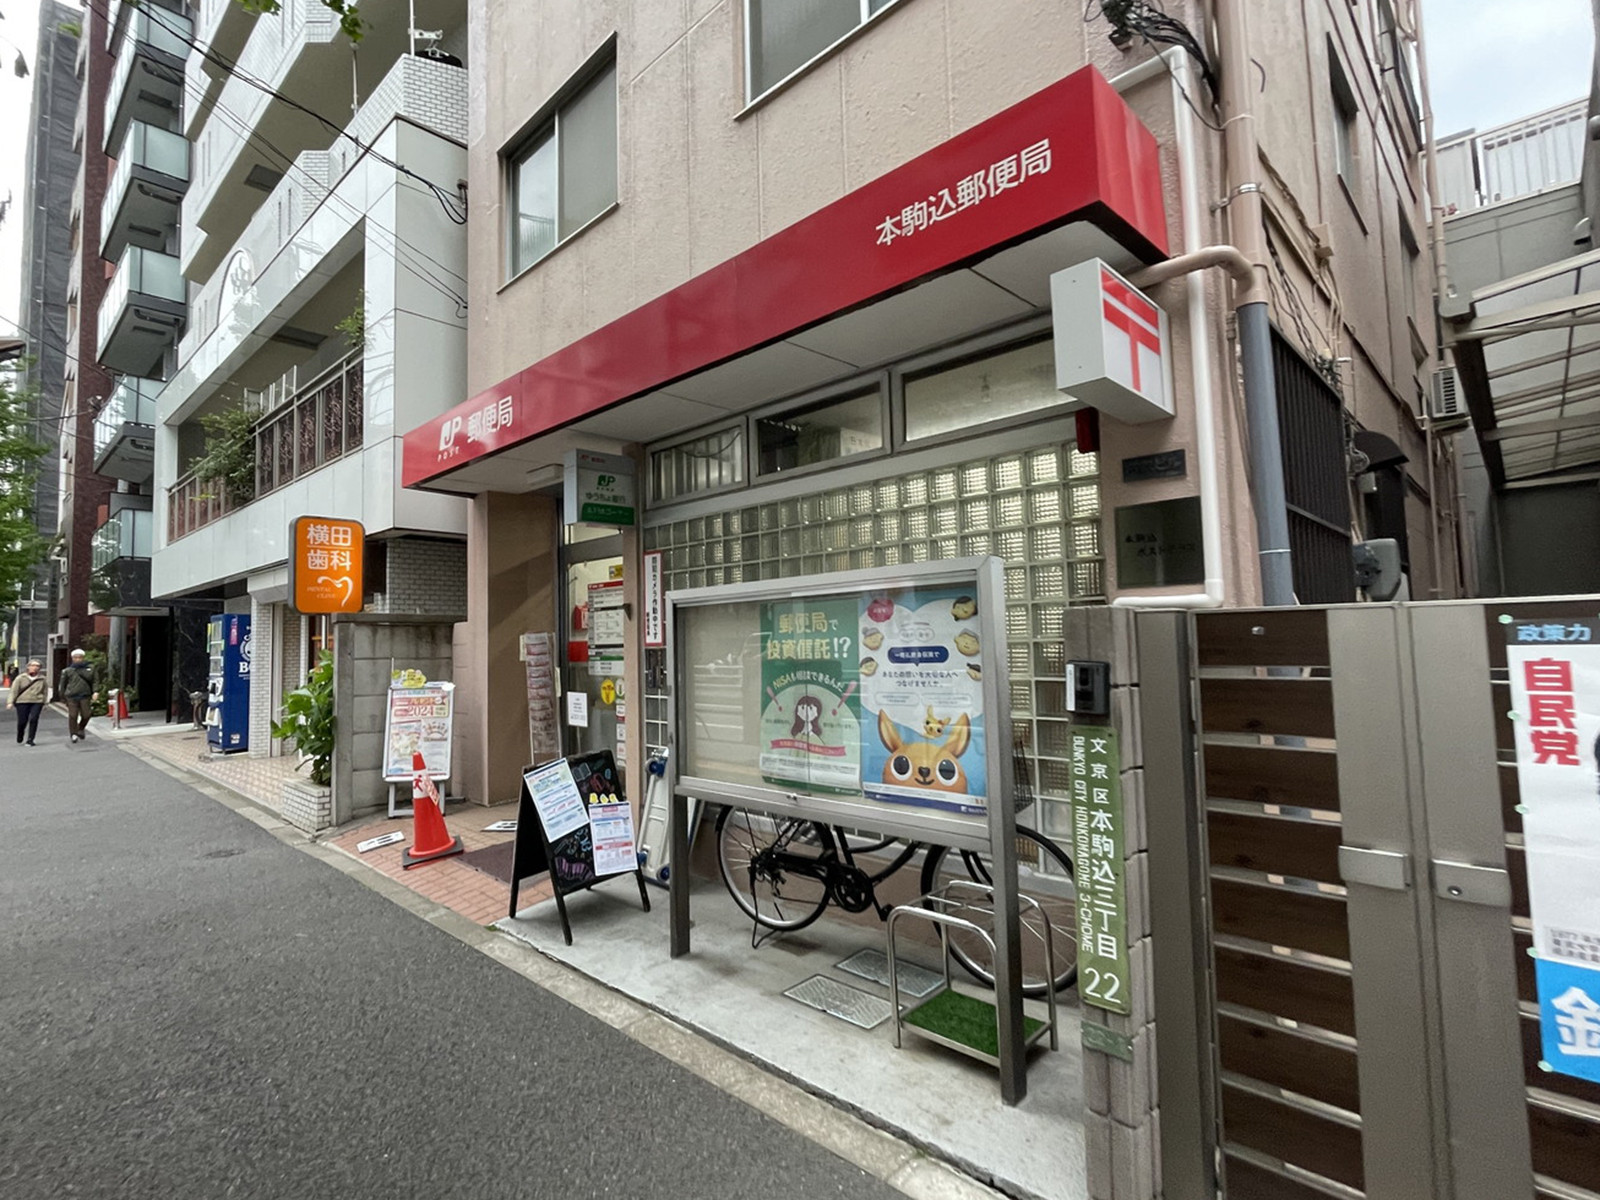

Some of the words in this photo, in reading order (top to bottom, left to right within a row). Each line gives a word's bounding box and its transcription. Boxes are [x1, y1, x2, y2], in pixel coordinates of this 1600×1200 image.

[875, 138, 1052, 245] 本駒込郵便局
[467, 395, 513, 443] 郵便局
[437, 446, 460, 462] POST
[307, 523, 352, 547] 横田
[307, 549, 352, 571] 歯科
[778, 612, 839, 634] 郵便局で
[1516, 624, 1592, 642] 政策力
[1523, 658, 1581, 766] 自民党
[1072, 736, 1086, 775] BUNKYO
[1074, 780, 1088, 803] CITY
[1075, 806, 1091, 888] HONKOMAGOME
[1090, 737, 1118, 960] 文京区本駒込三丁目
[1079, 893, 1094, 954] 3-CHOME
[1084, 967, 1122, 1004] 22
[1551, 986, 1600, 1057] 金
